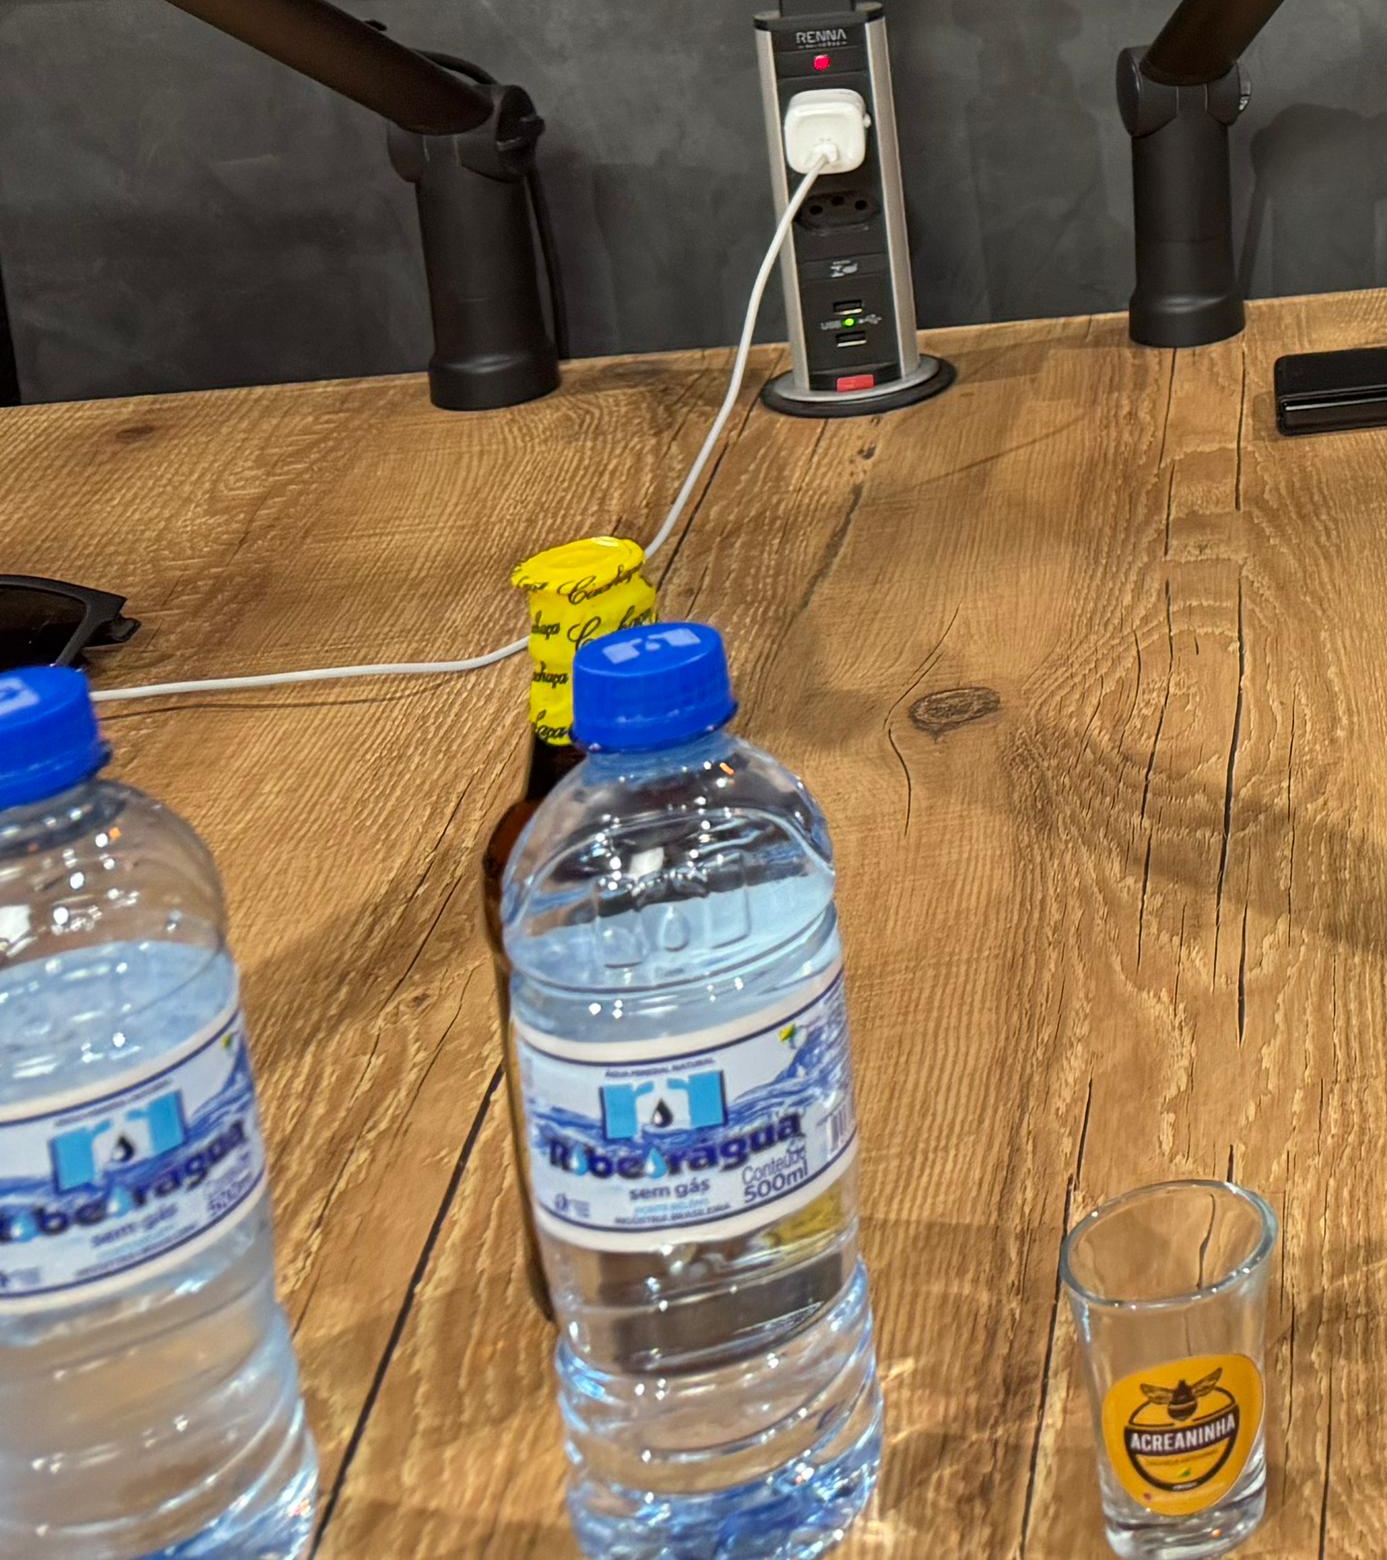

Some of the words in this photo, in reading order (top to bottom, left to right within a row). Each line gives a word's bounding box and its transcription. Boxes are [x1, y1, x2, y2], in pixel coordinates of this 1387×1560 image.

[795, 28, 847, 44] RENNA
[629, 1185, 670, 1201] sem
[674, 1177, 711, 1199] gás
[743, 1159, 809, 1204] 500ml
[1130, 1413, 1236, 1452] ACREANINHA
